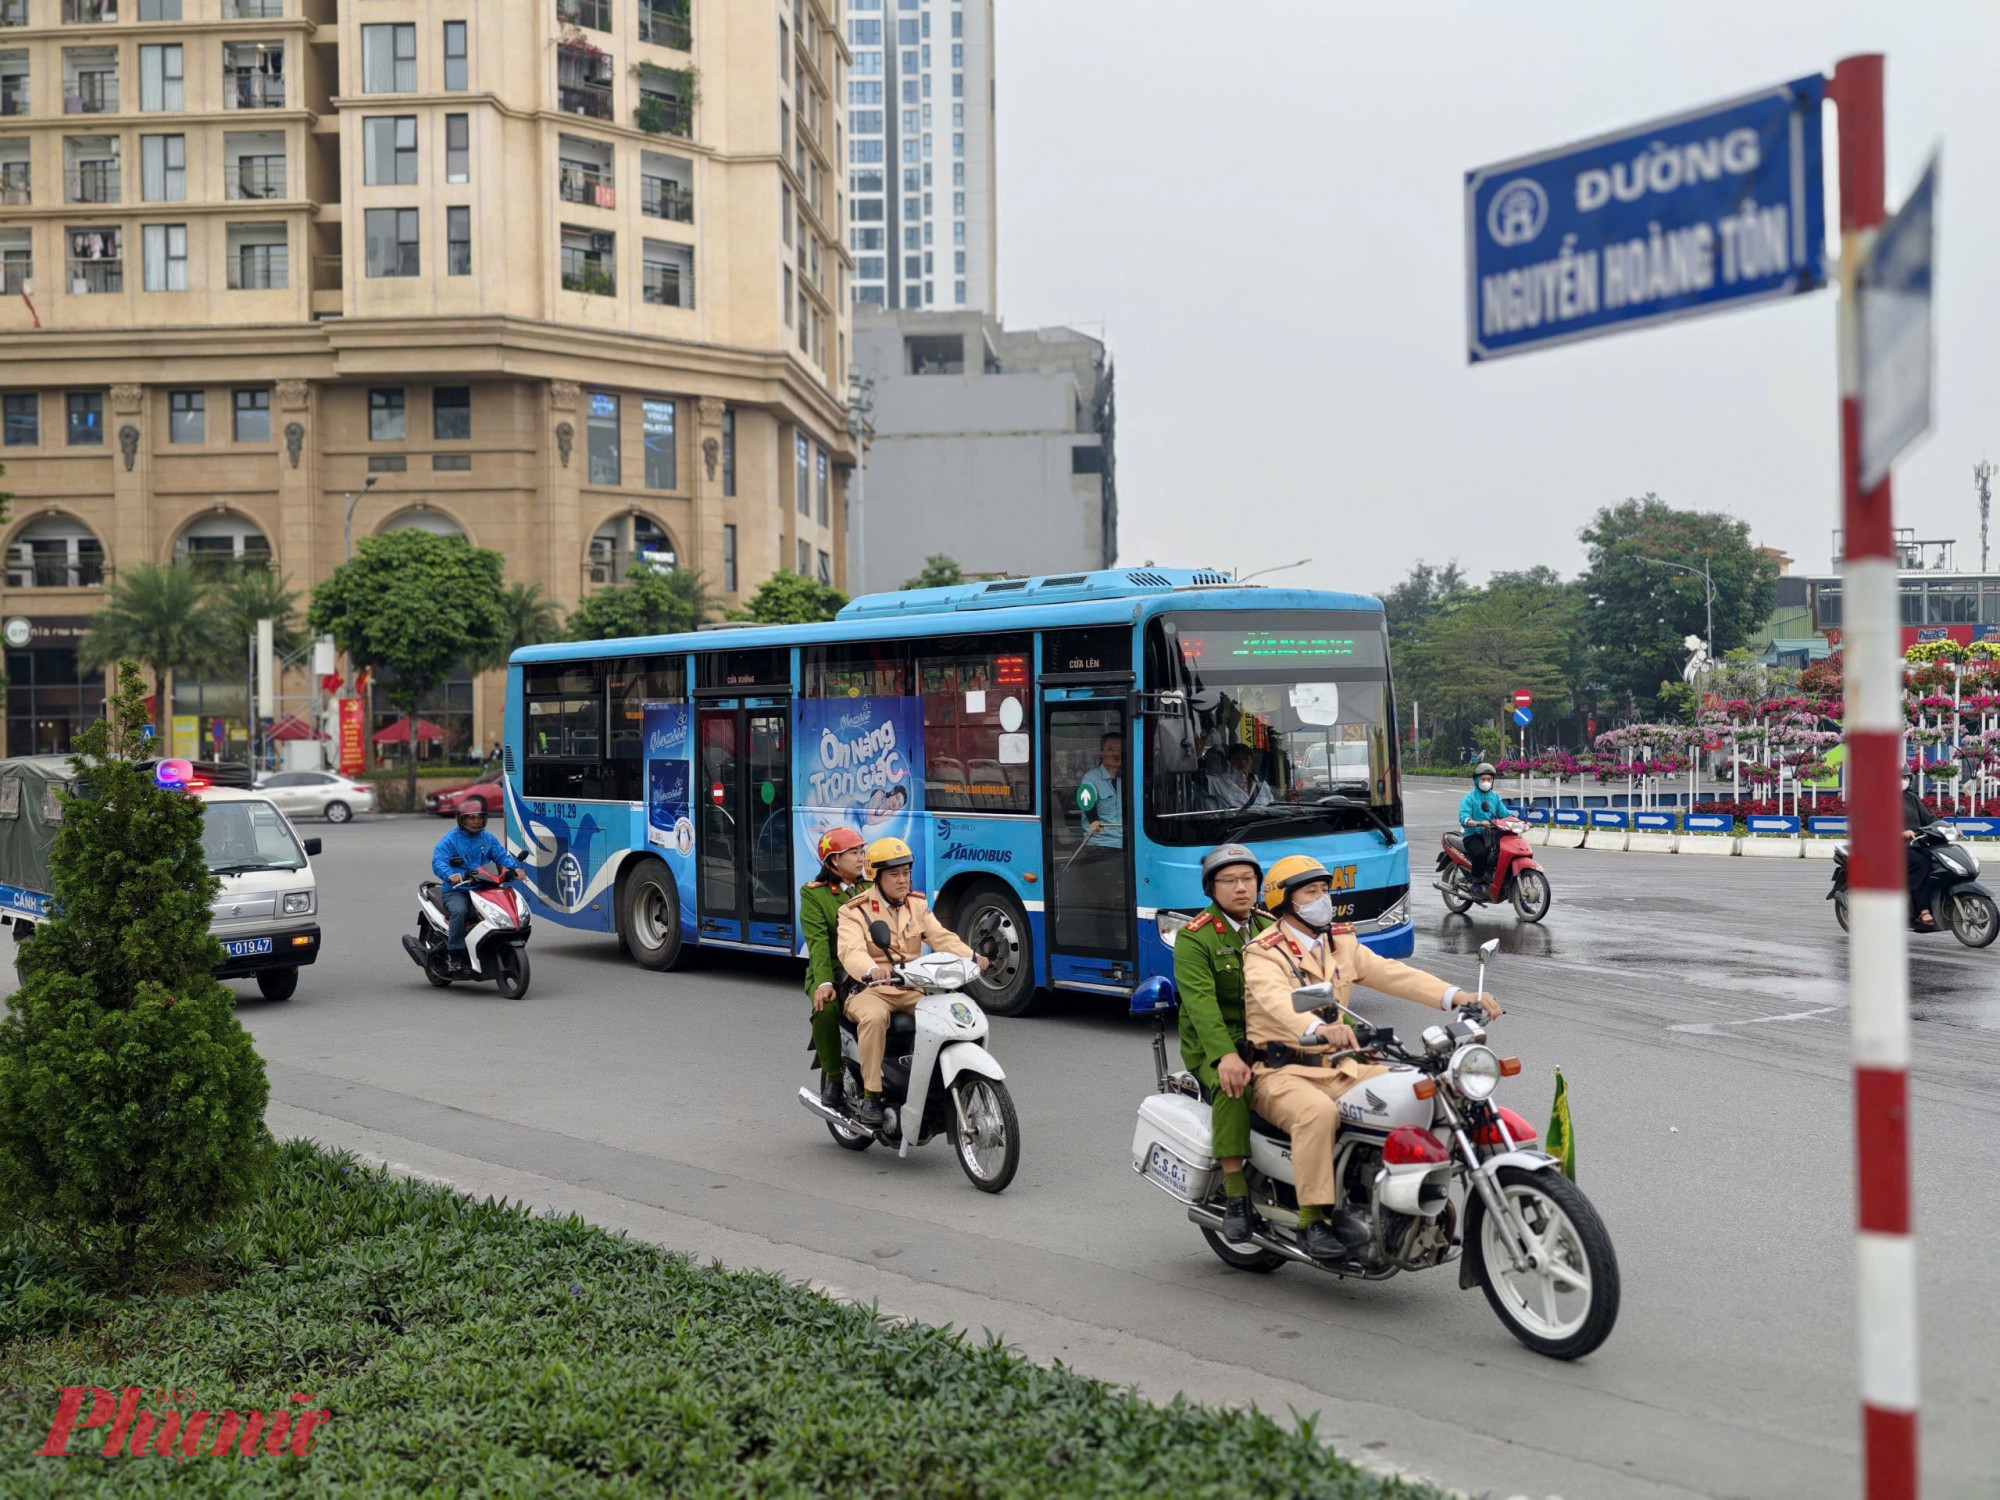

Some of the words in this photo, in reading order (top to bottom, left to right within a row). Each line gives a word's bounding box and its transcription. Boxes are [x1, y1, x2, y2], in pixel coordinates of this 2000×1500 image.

[1603, 220, 1714, 309] HOÀNG
[1086, 658, 1100, 668] LÊN
[533, 802, 546, 817] 29B
